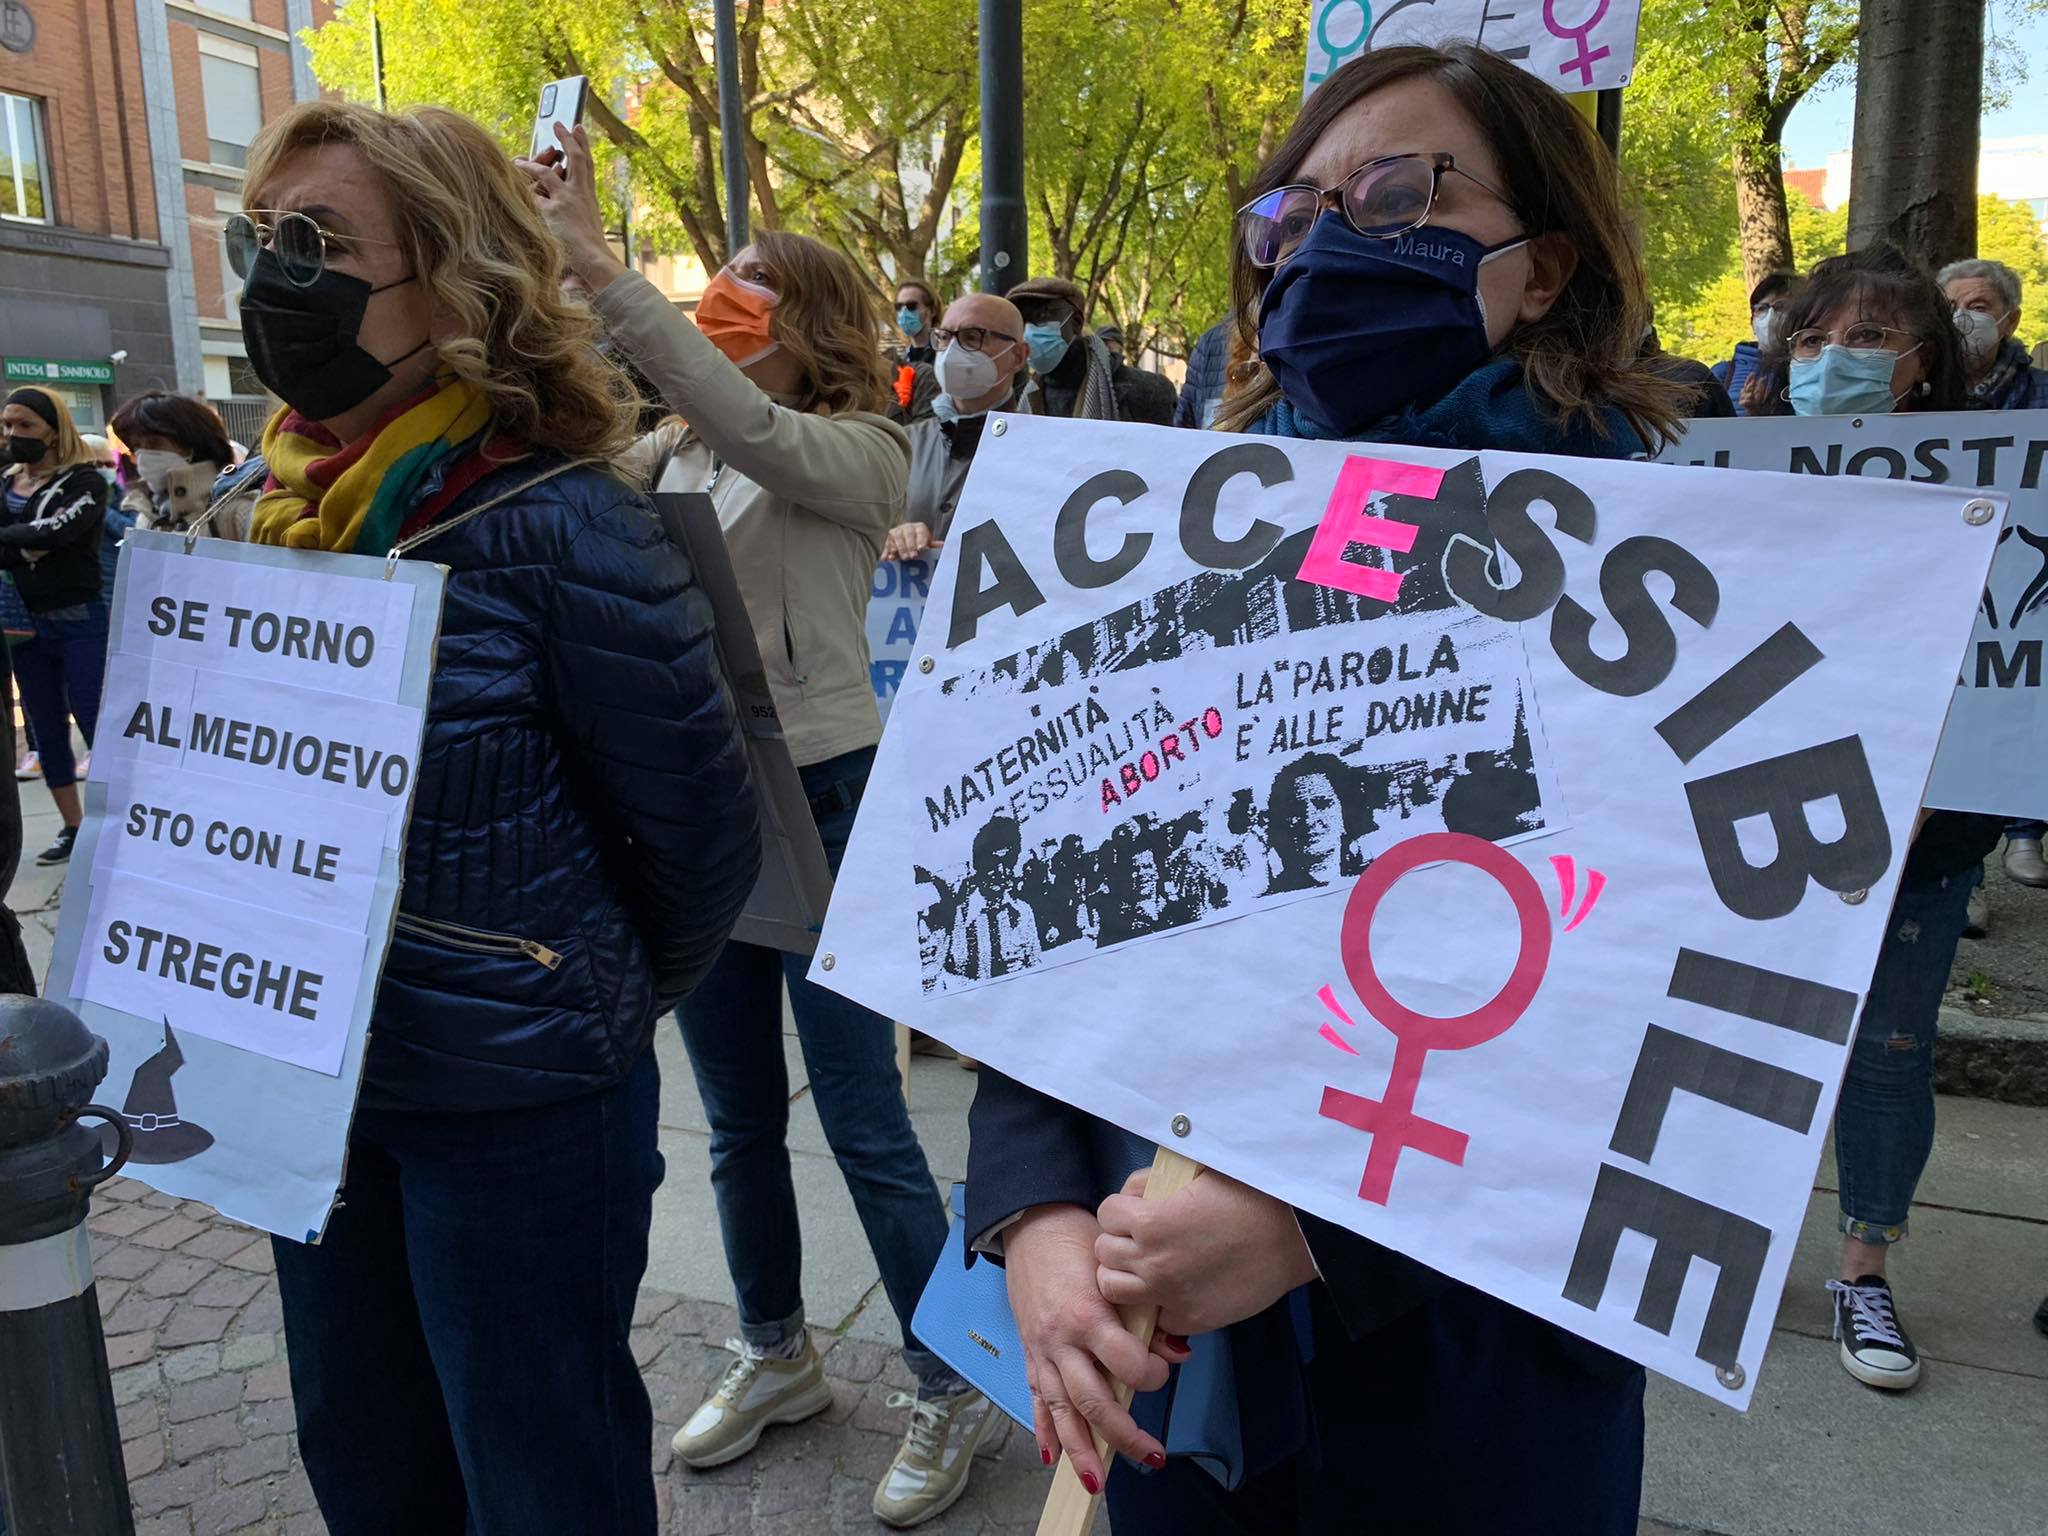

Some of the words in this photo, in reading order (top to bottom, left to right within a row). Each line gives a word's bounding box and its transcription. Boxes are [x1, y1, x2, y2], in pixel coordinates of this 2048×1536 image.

[1394, 233, 1465, 267] Maura
[7, 362, 44, 376] INTESA
[147, 596, 209, 642] SE
[224, 606, 375, 668] TORNO
[123, 701, 181, 749] AL
[189, 712, 410, 797] MEDIOEVO
[1268, 705, 1344, 754] ALLE
[1366, 684, 1492, 738] DONNE
[1101, 706, 1223, 815] ABORTO
[126, 803, 194, 847] STO
[205, 821, 282, 869] CON
[292, 839, 341, 882] LE
[945, 442, 1892, 1370] ACCESSIBILE
[103, 920, 324, 1021] STREGHE
